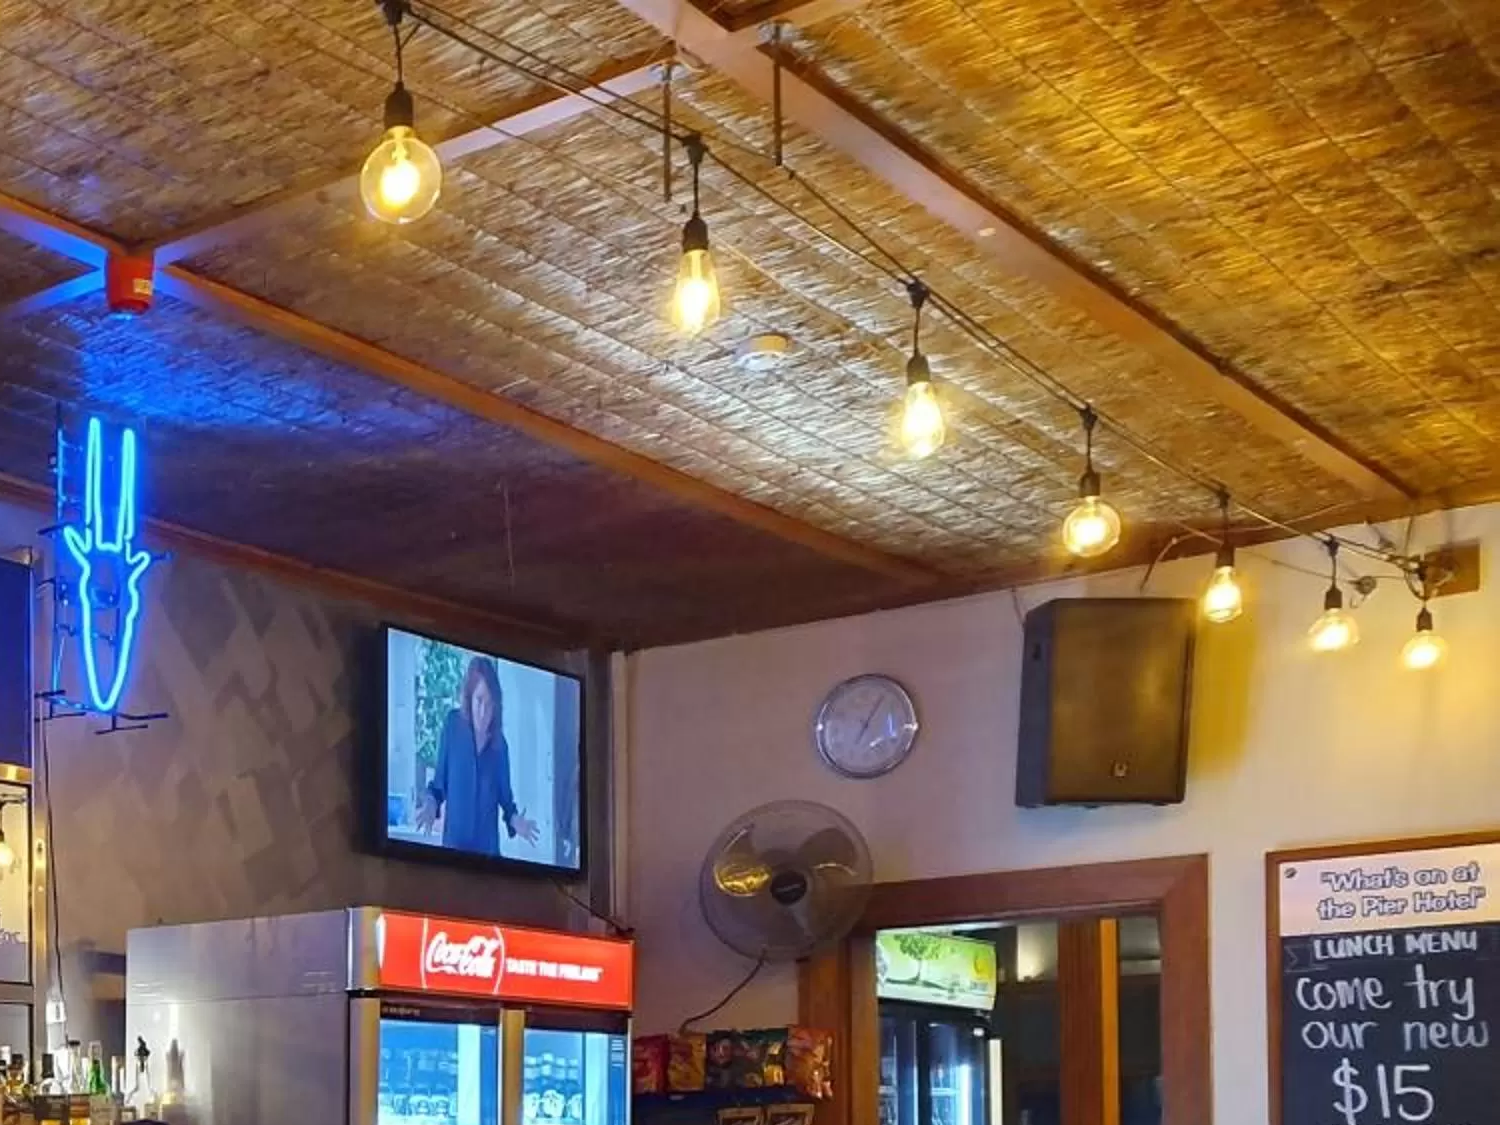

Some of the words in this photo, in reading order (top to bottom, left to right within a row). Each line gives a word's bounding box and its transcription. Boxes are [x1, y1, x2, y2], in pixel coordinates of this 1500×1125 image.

[1414, 867, 1448, 887] on
[1452, 860, 1482, 884] at
[1317, 897, 1355, 921] the
[1361, 894, 1408, 918] Pier
[1313, 934, 1394, 961] LUNCH
[1405, 930, 1478, 955] MENU
[1404, 963, 1476, 1021] try
[1302, 1019, 1379, 1050] our
[1403, 1020, 1490, 1051] new
